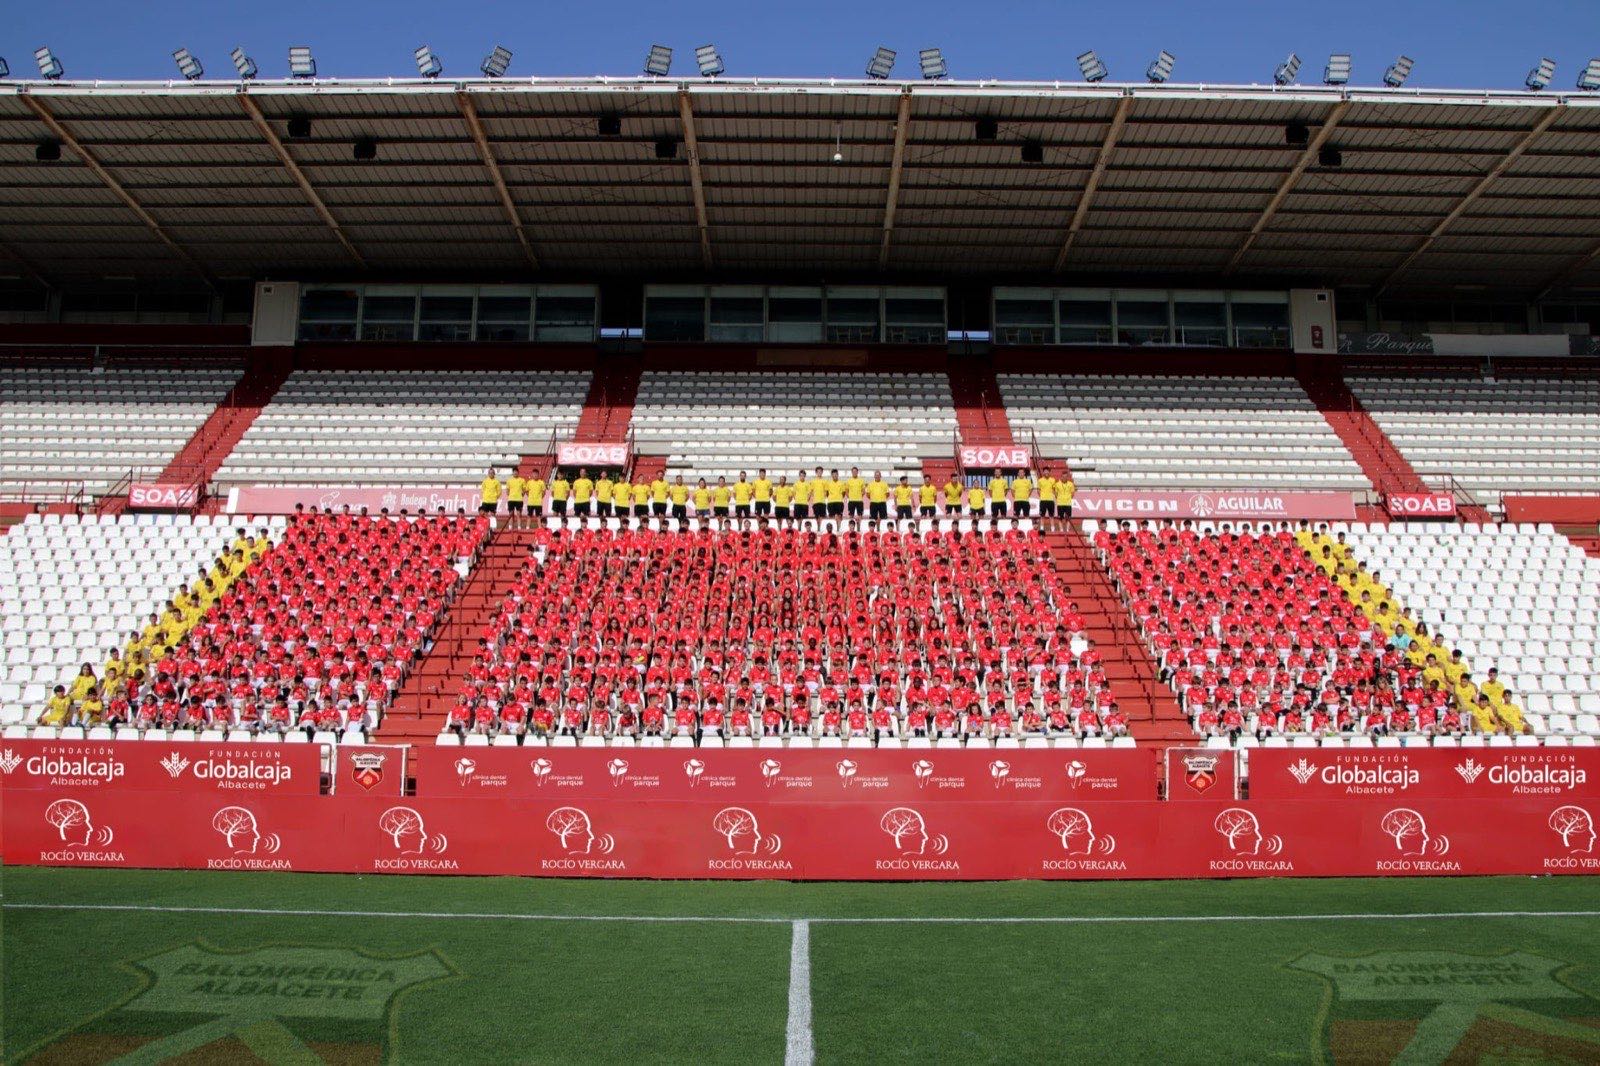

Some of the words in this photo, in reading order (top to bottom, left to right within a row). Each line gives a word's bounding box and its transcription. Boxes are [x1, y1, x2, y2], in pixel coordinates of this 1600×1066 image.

[562, 447, 625, 462] SOAB
[962, 449, 1028, 465] SOAB
[132, 489, 194, 504] SOAB
[430, 493, 466, 512] Santa
[1217, 497, 1284, 511] AGUILAR
[1391, 497, 1452, 512] SOAB
[43, 747, 113, 755] FUNDACIÓN
[210, 750, 280, 758] FUNDACIÓN
[1337, 754, 1407, 762] FUNDACIÓN
[1504, 754, 1574, 762] FUNDACIÓN
[27, 757, 124, 785] Globalcaja
[194, 759, 291, 785] Globalcaja
[1322, 765, 1419, 789] Globalcaja
[1489, 765, 1586, 789] Globalcaja
[51, 778, 99, 786] Albacete
[218, 781, 266, 789] Albacete
[633, 780, 659, 788] parque
[863, 781, 889, 789] parque
[1016, 782, 1042, 790] parque
[1092, 782, 1118, 790] parque
[1346, 785, 1394, 793] Albacete
[1513, 785, 1561, 793] Albacete
[41, 849, 74, 861] ROCÍO
[77, 851, 124, 861] VERGARA
[208, 856, 241, 868] ROCÍO
[244, 858, 291, 868] VERGARA
[375, 857, 408, 869] ROCÍO
[411, 859, 458, 869] VERGARA
[542, 857, 575, 869] ROCÍO
[578, 859, 625, 869] VERGARA
[709, 857, 742, 869] ROCÍO
[745, 859, 792, 869] VERGARA
[876, 857, 909, 870] ROCÍO
[912, 859, 959, 870] VERGARA
[1043, 857, 1076, 870] ROCÍO
[1079, 859, 1126, 870] VERGARA
[1211, 858, 1244, 870] ROCÍO
[1247, 860, 1294, 870] VERGARA
[1377, 858, 1410, 870] ROCÍO
[1413, 860, 1460, 870] VERGARA
[1544, 856, 1577, 868] ROCÍO
[1580, 858, 1600, 868] VER
[191, 980, 369, 999] ALBACETE
